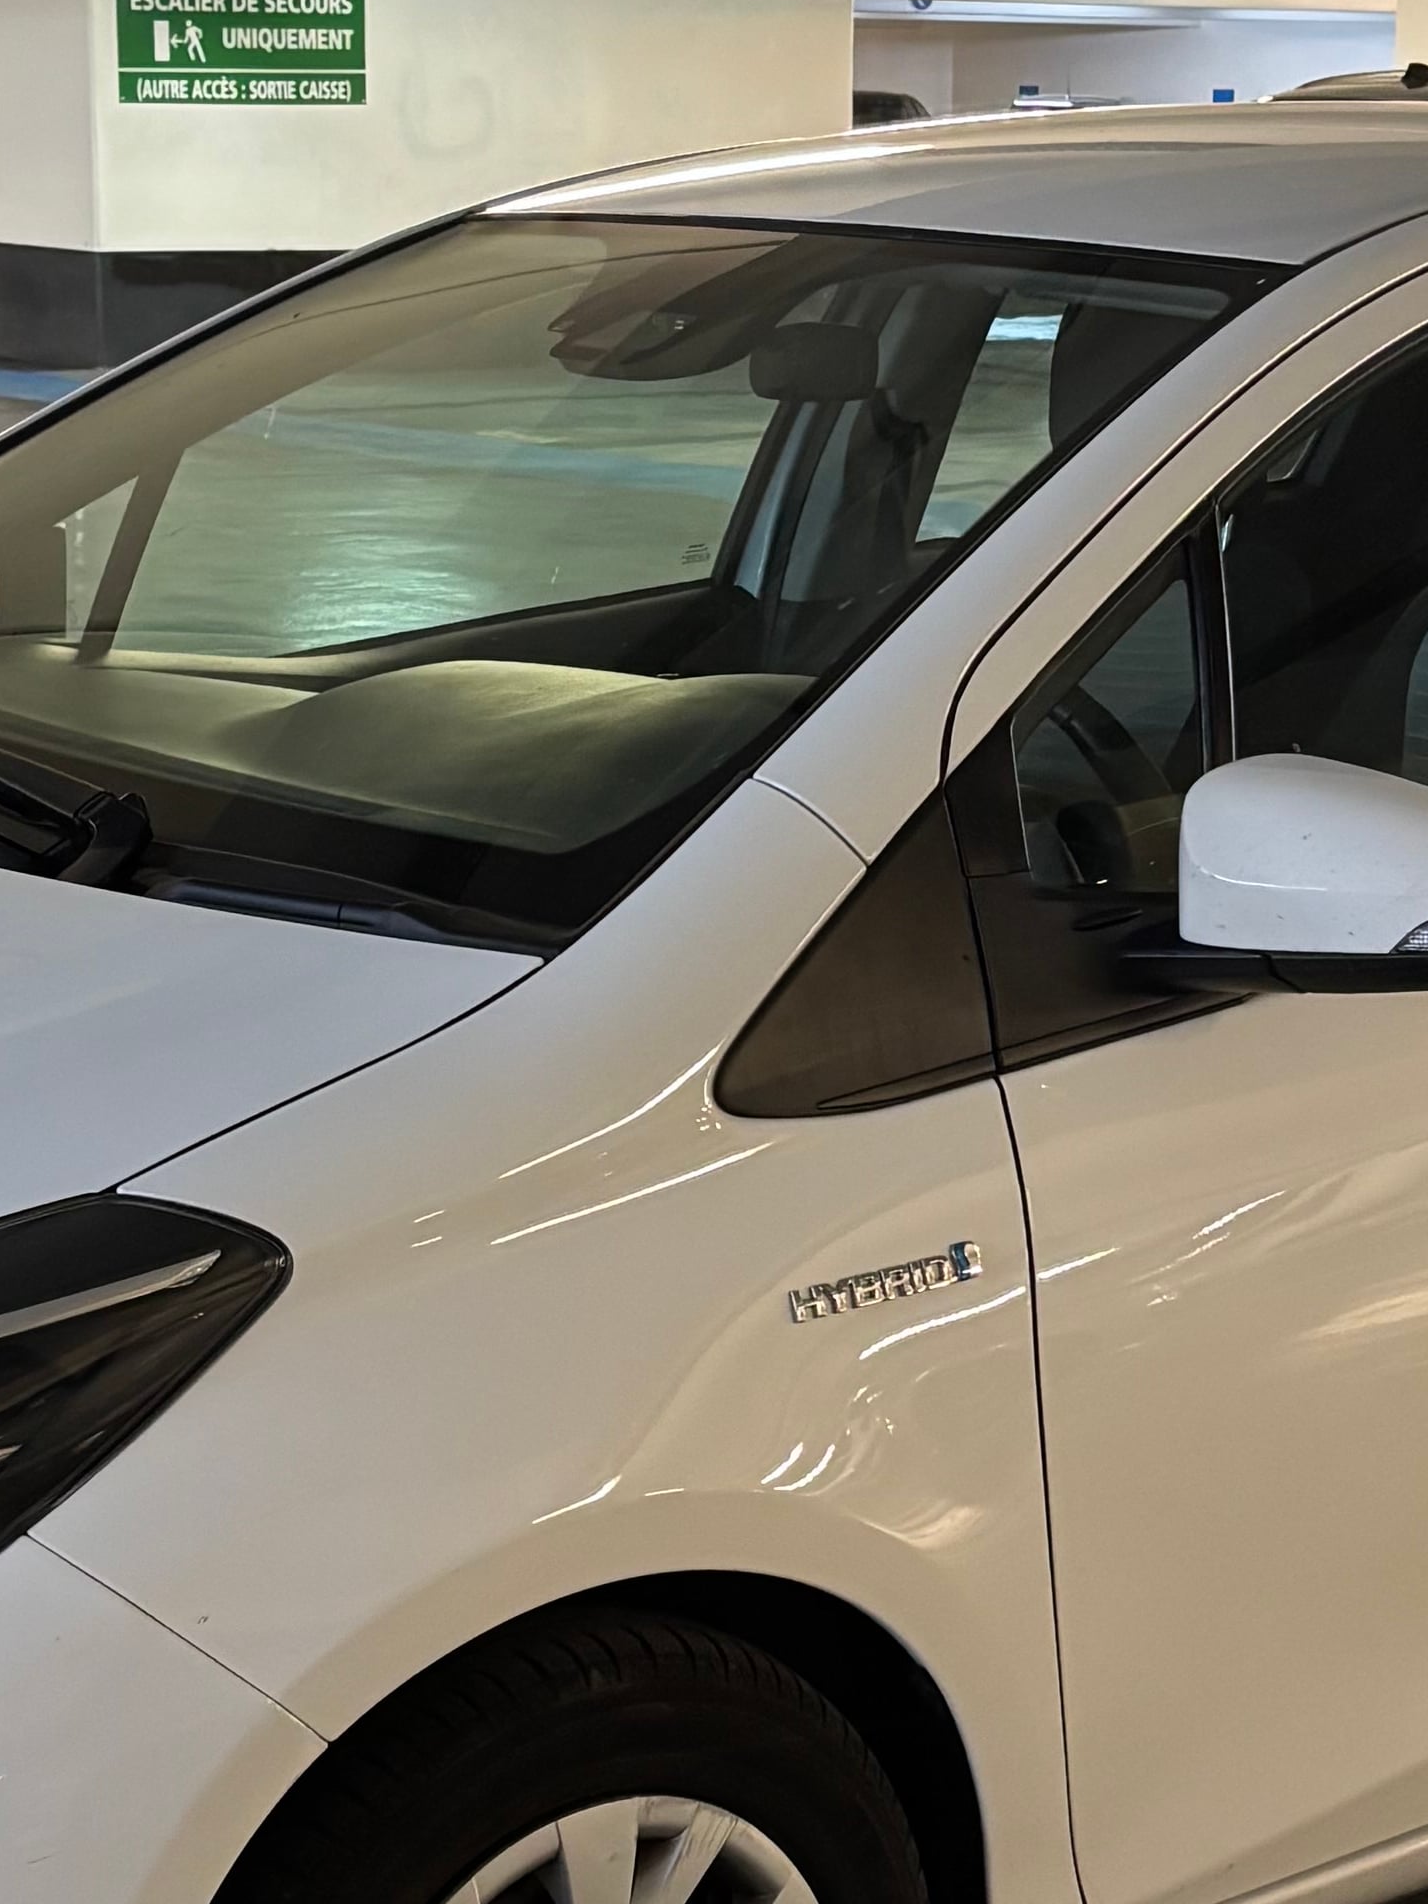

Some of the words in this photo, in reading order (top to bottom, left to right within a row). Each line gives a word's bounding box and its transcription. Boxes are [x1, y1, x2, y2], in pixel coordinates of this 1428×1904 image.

[222, 27, 354, 52] UNIQUEMENT
[136, 78, 188, 102] (AUTRE
[192, 76, 238, 100] ACCÈS
[249, 79, 297, 101] SORTIE
[299, 79, 352, 102] CAISSE)
[788, 1254, 959, 1325] HYBRID
